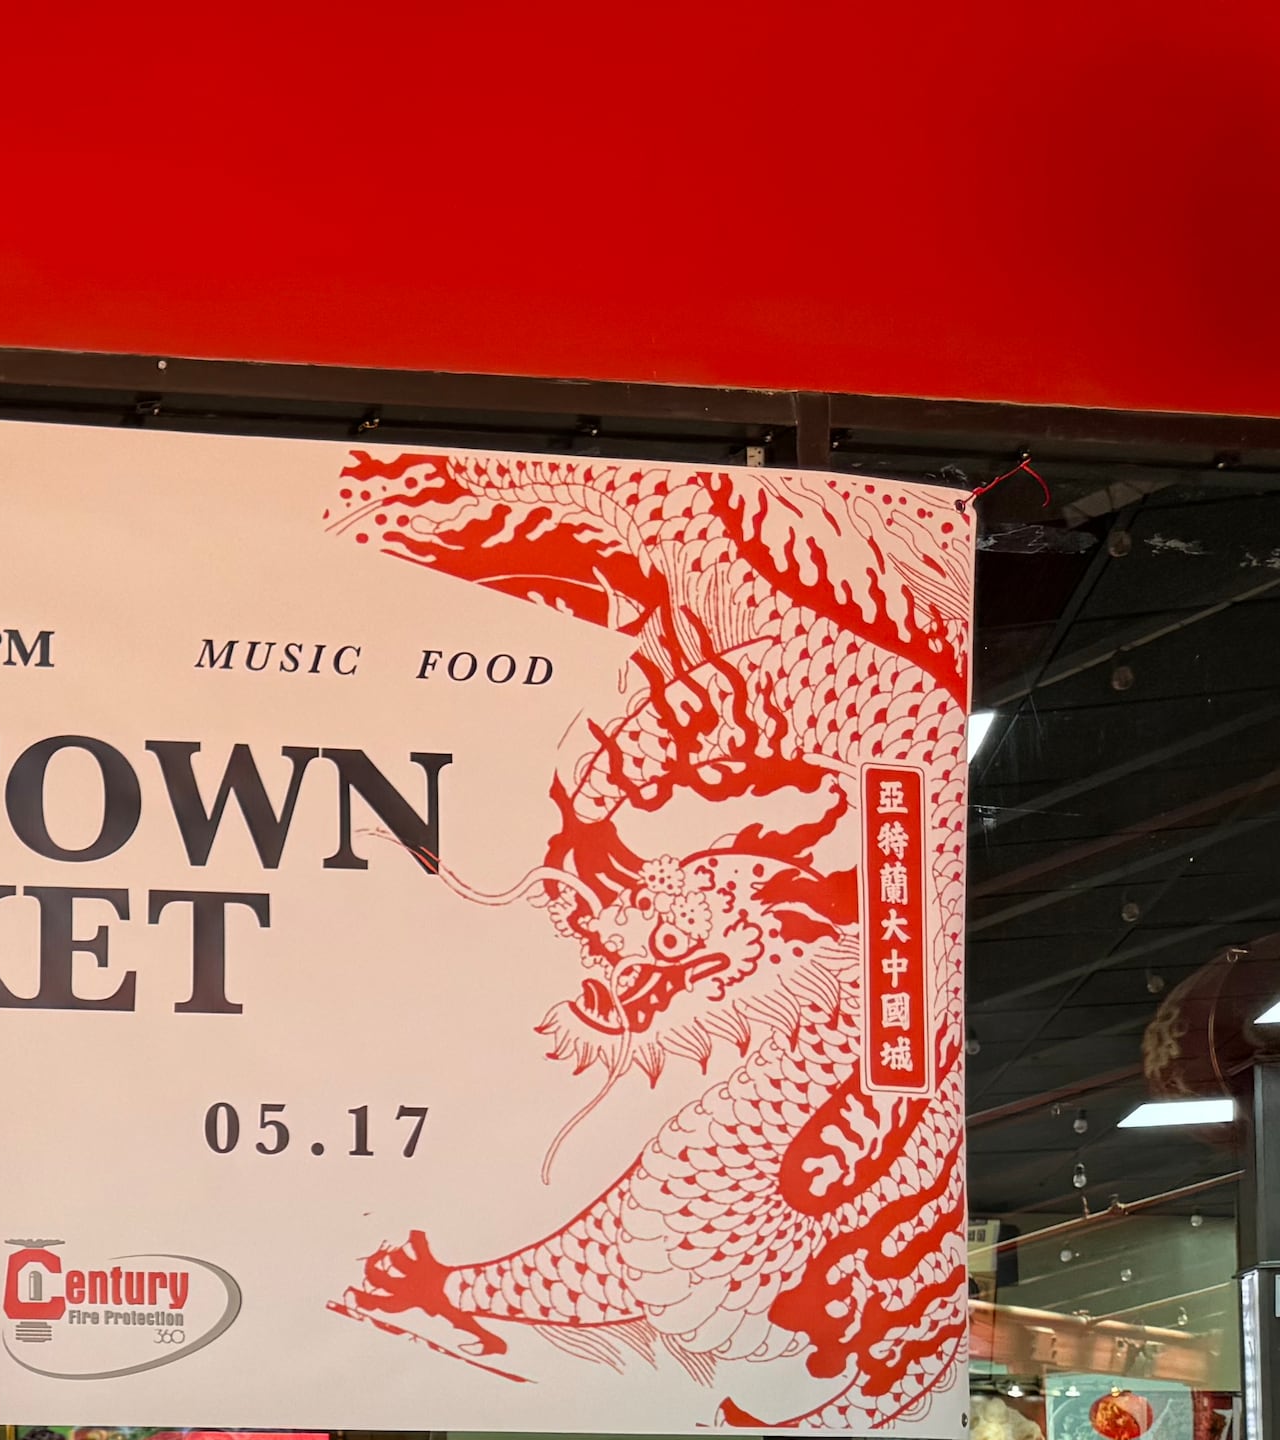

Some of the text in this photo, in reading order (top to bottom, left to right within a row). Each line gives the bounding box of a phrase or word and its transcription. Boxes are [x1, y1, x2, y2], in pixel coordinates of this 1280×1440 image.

[194, 639, 553, 685] MUSIC FOOD
[875, 780, 914, 1072] 亞特蘭大中國城
[204, 1102, 429, 1158] 05.17
[2, 1247, 190, 1320] Century
[67, 1309, 185, 1327] Fire Protection
